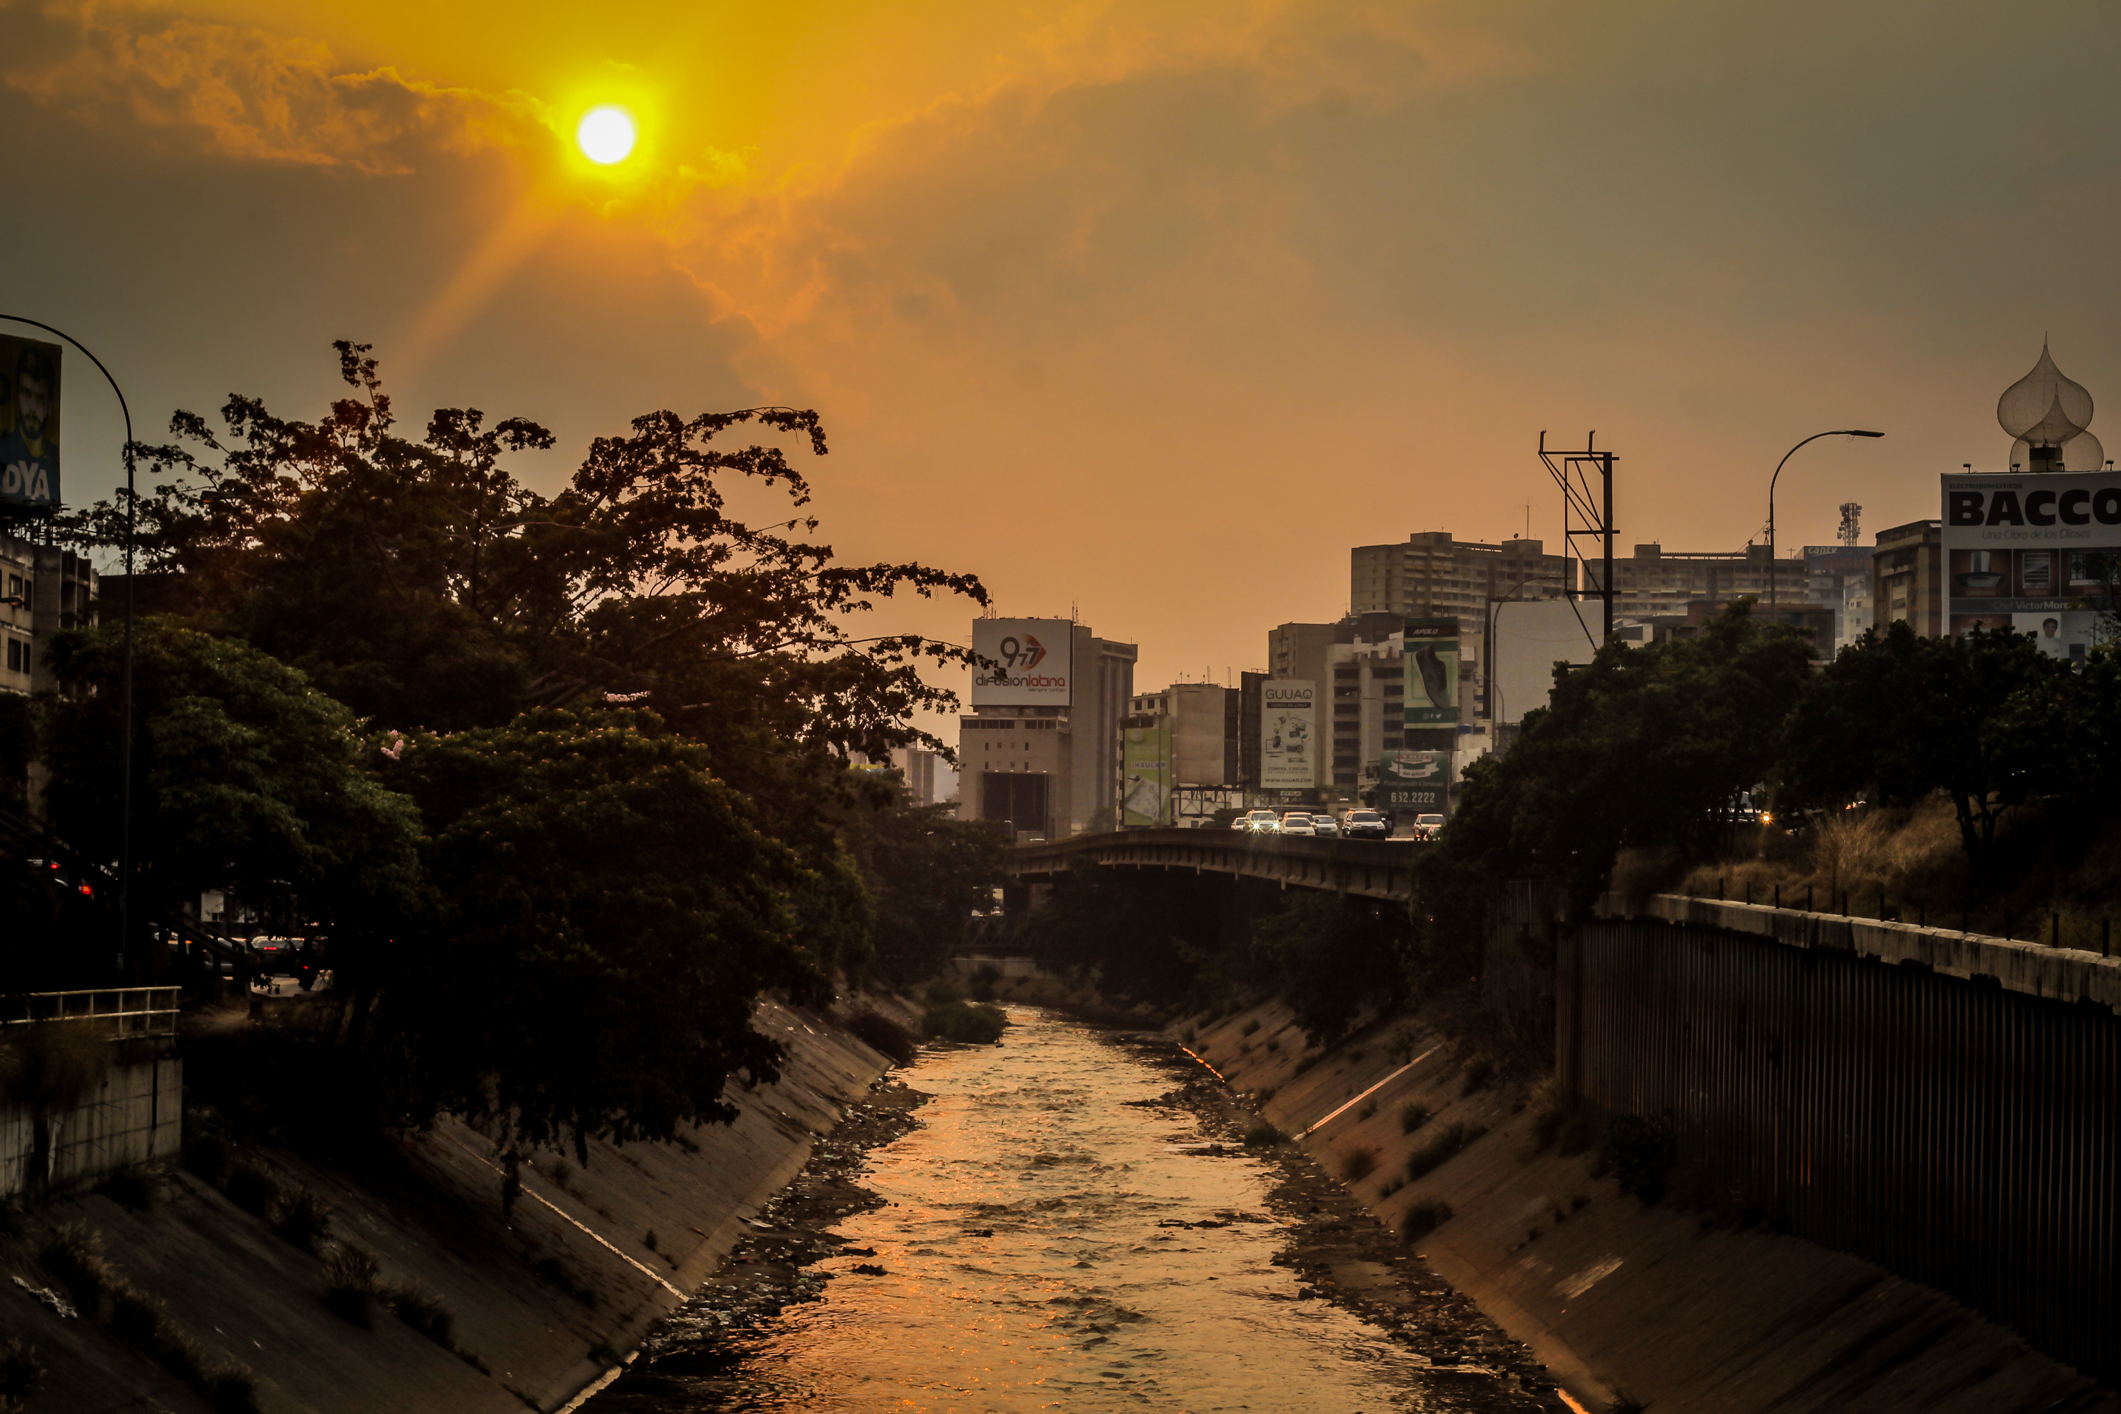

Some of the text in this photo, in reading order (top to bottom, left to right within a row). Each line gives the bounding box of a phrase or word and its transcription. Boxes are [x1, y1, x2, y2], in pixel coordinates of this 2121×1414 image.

[0, 459, 51, 500] DYA
[1949, 488, 2121, 526] BACCO
[1982, 528, 2091, 540] Una Obra de los Dioses
[1808, 547, 1838, 555] cantv
[1000, 636, 1041, 668] 97.7
